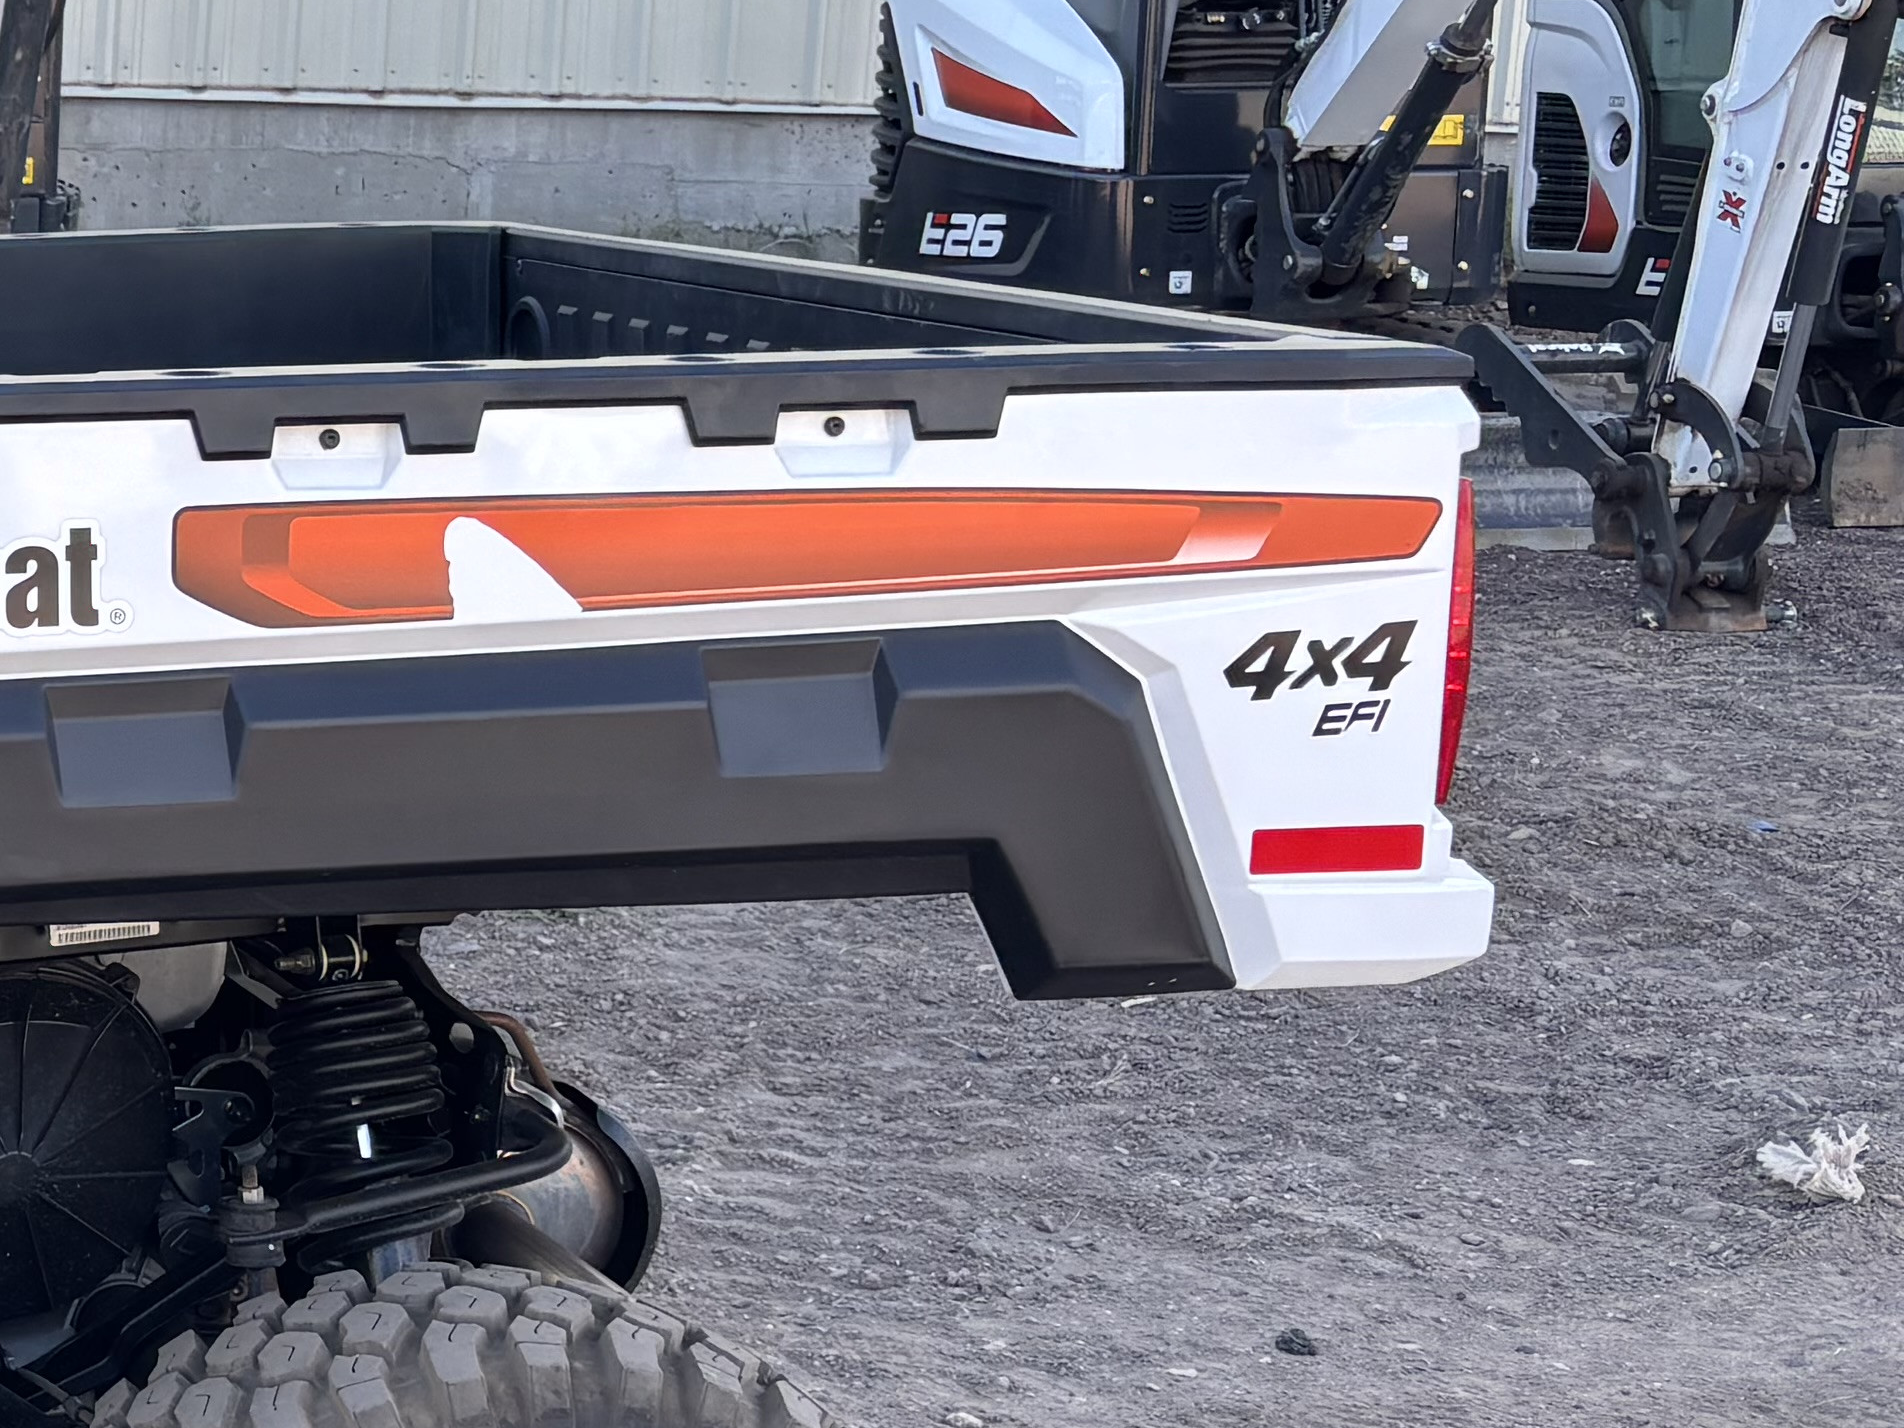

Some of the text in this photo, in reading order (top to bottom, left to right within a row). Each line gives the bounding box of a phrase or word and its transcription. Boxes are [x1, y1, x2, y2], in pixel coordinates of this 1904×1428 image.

[1812, 95, 1868, 225] LongArm
[919, 212, 1007, 258] E26
[1223, 619, 1419, 701] 4x4
[1312, 698, 1392, 737] EFI
